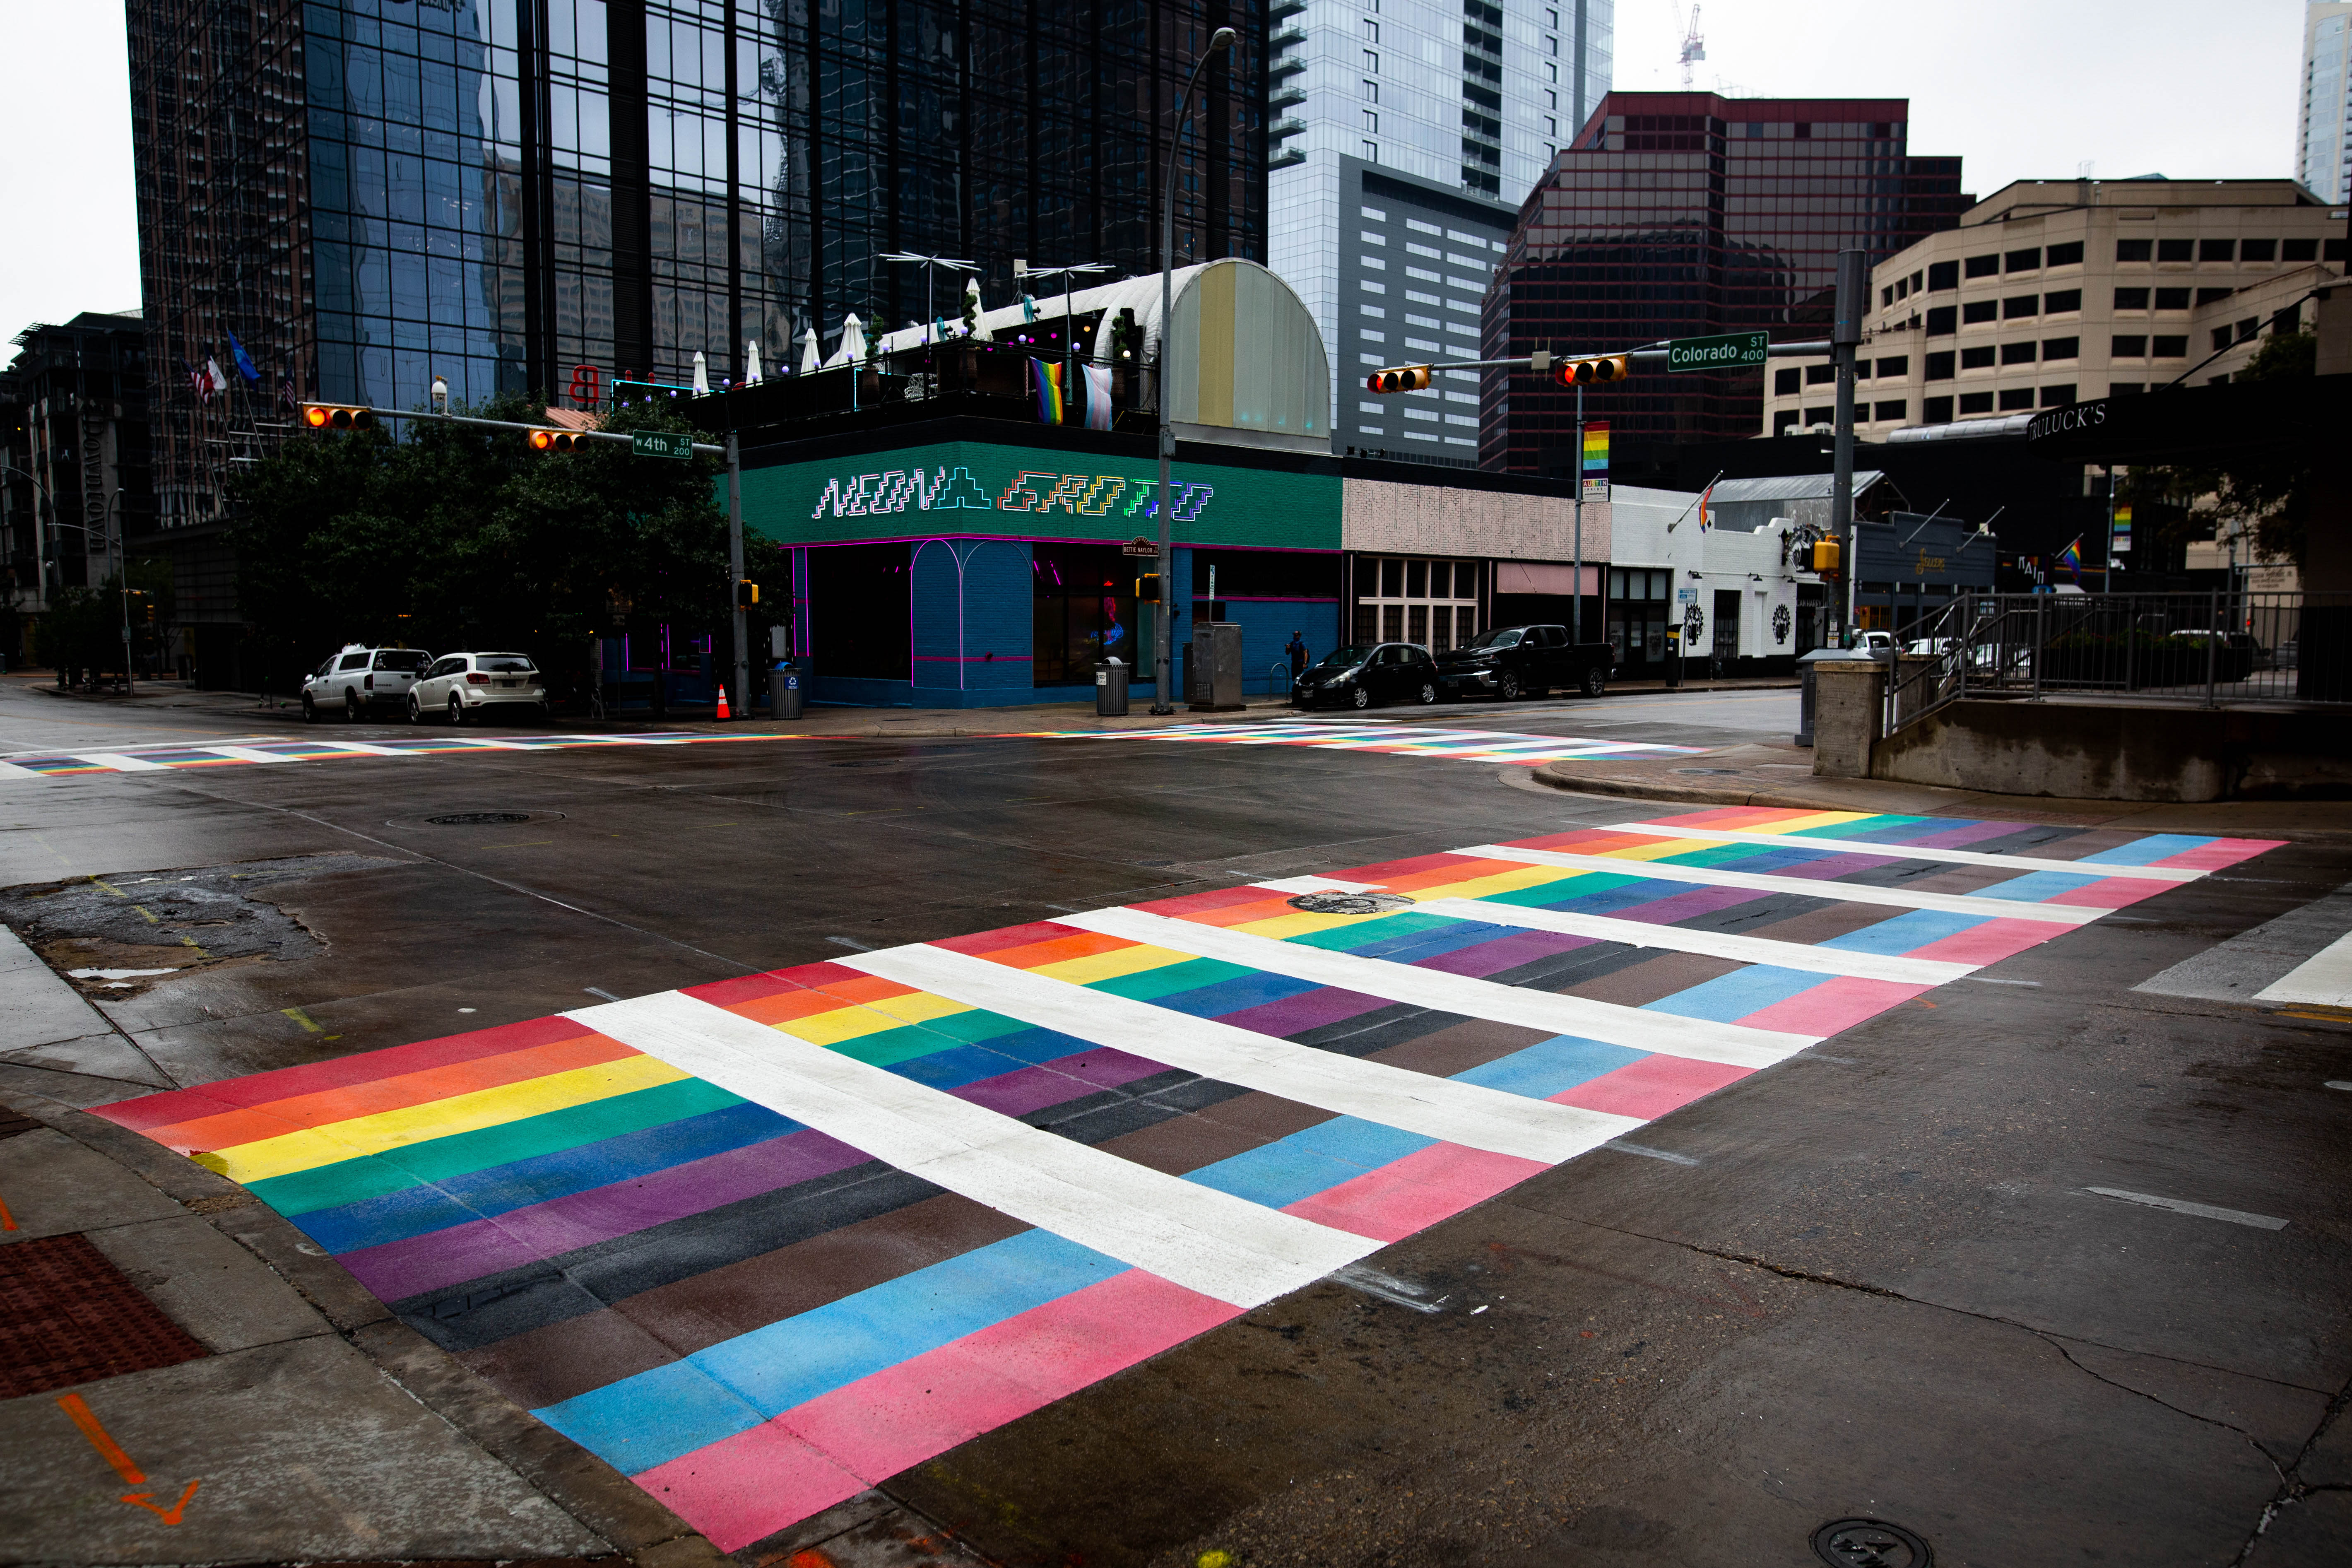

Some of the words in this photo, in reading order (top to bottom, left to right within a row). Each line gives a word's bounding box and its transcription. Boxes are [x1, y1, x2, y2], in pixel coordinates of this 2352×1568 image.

[1750, 336, 1765, 347] ST
[1672, 344, 1737, 363] Colorado
[1741, 349, 1764, 361] 400
[2029, 403, 2106, 442] TRULUCK'S
[644, 437, 667, 451] 4th
[674, 447, 690, 456] 200
[811, 466, 945, 518] NEON
[1138, 536, 1150, 545] STREET
